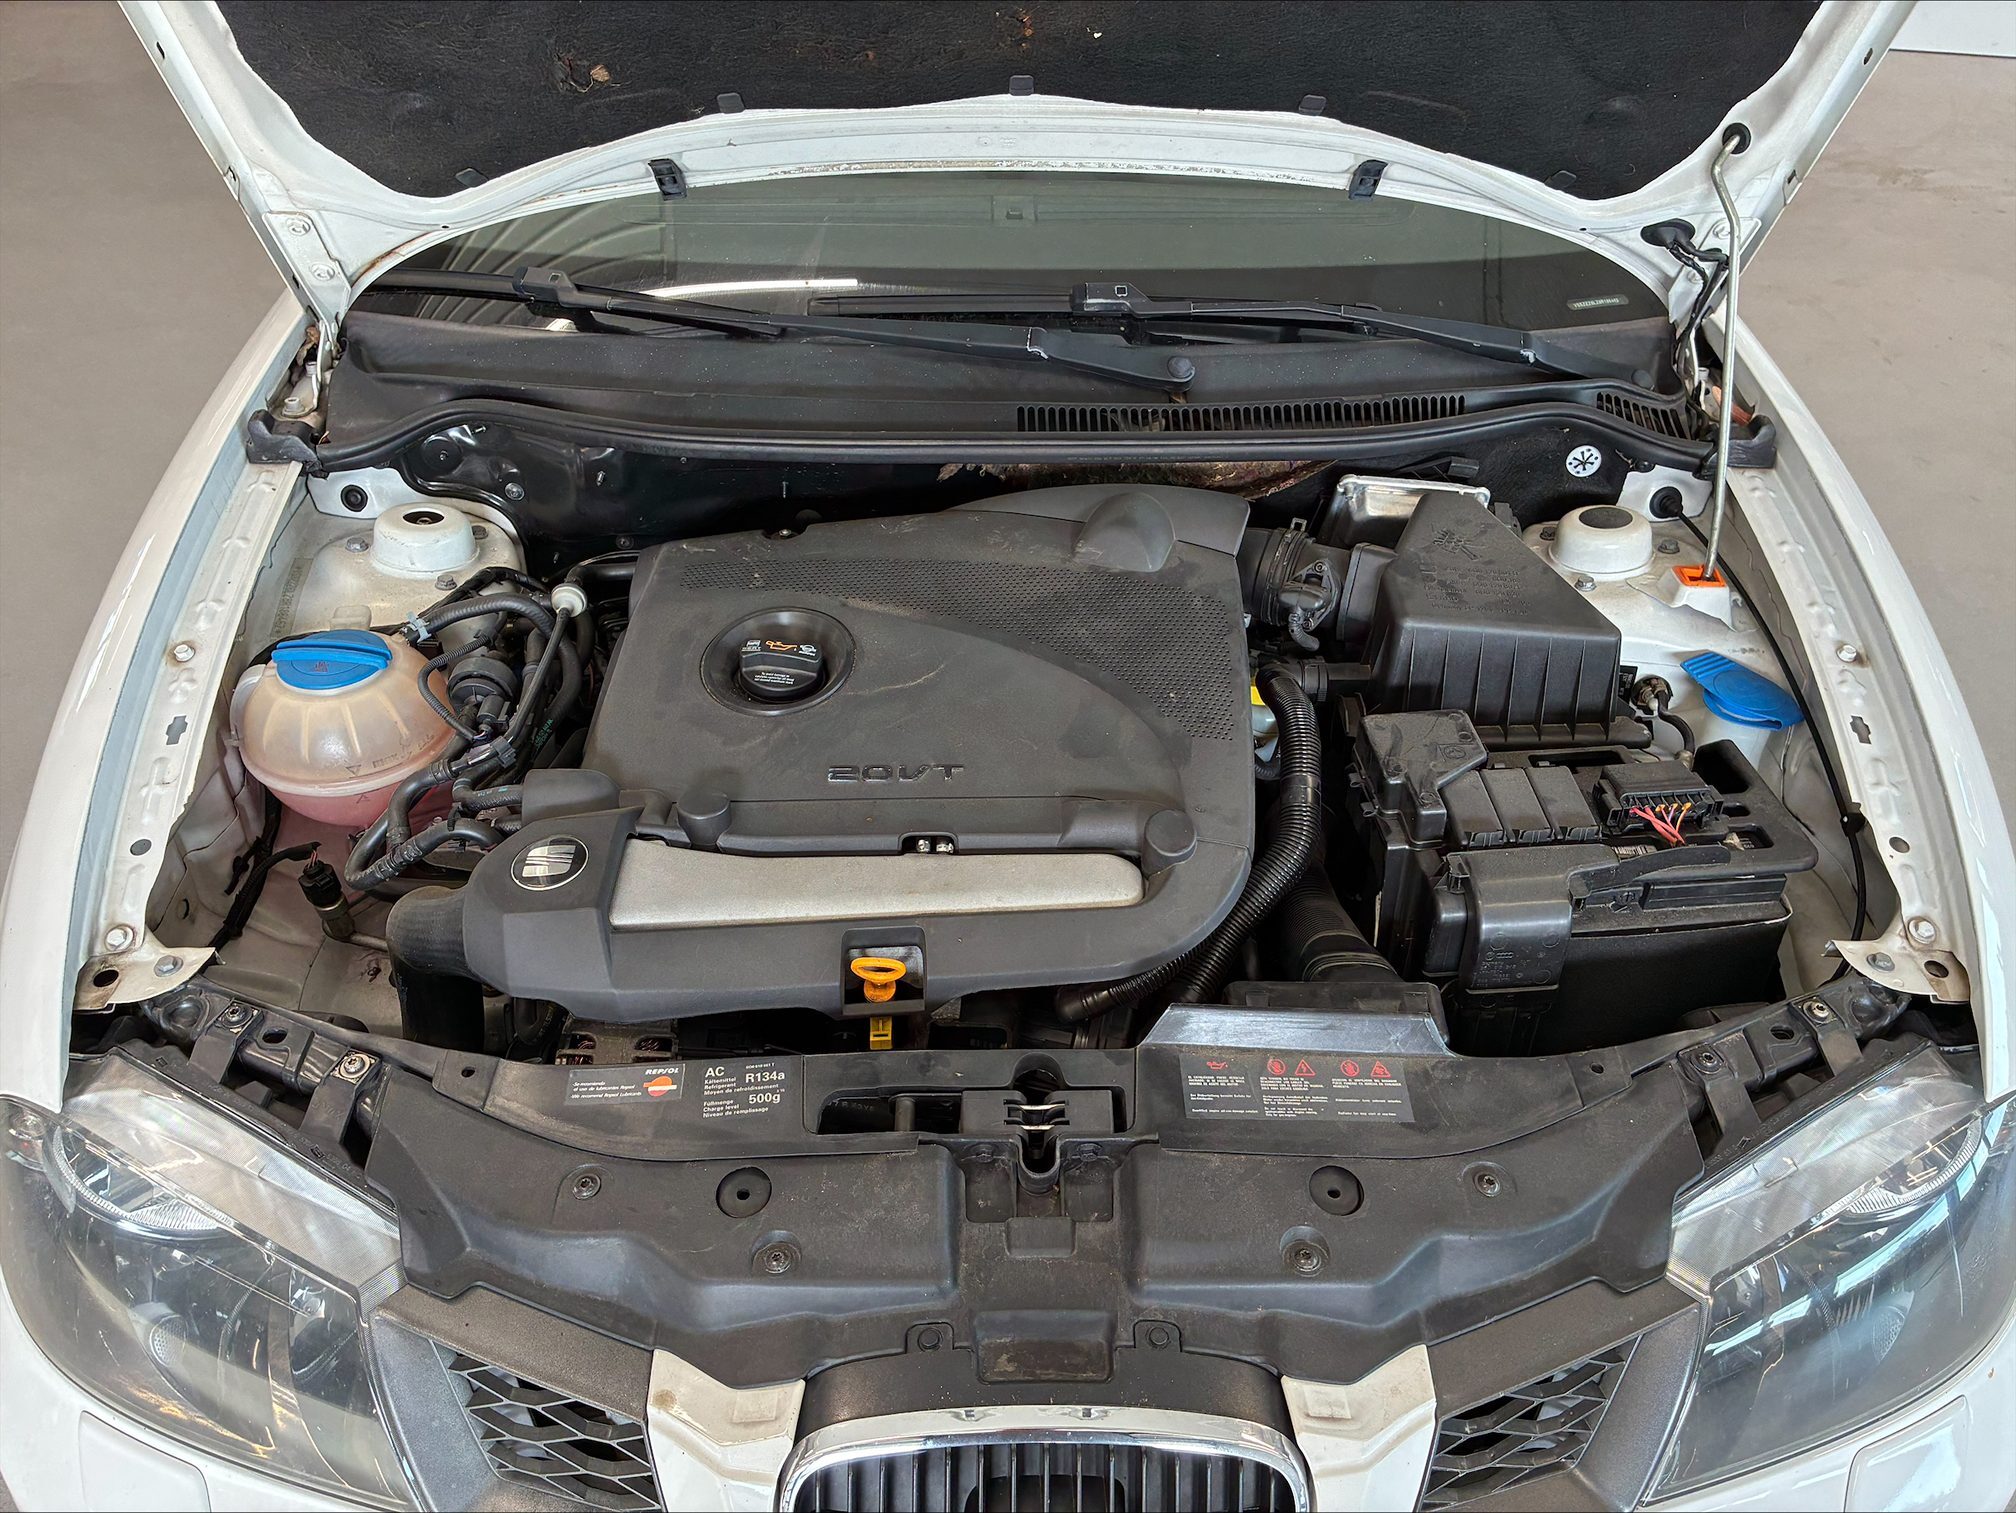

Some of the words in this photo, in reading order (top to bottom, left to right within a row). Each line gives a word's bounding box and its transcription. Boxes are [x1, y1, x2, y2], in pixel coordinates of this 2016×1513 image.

[705, 1067, 725, 1077] AC
[745, 1071, 785, 1083] R134a
[734, 1084, 779, 1092] refroidissement
[749, 1093, 780, 1104] 500g
[734, 1107, 768, 1115] remplissage
